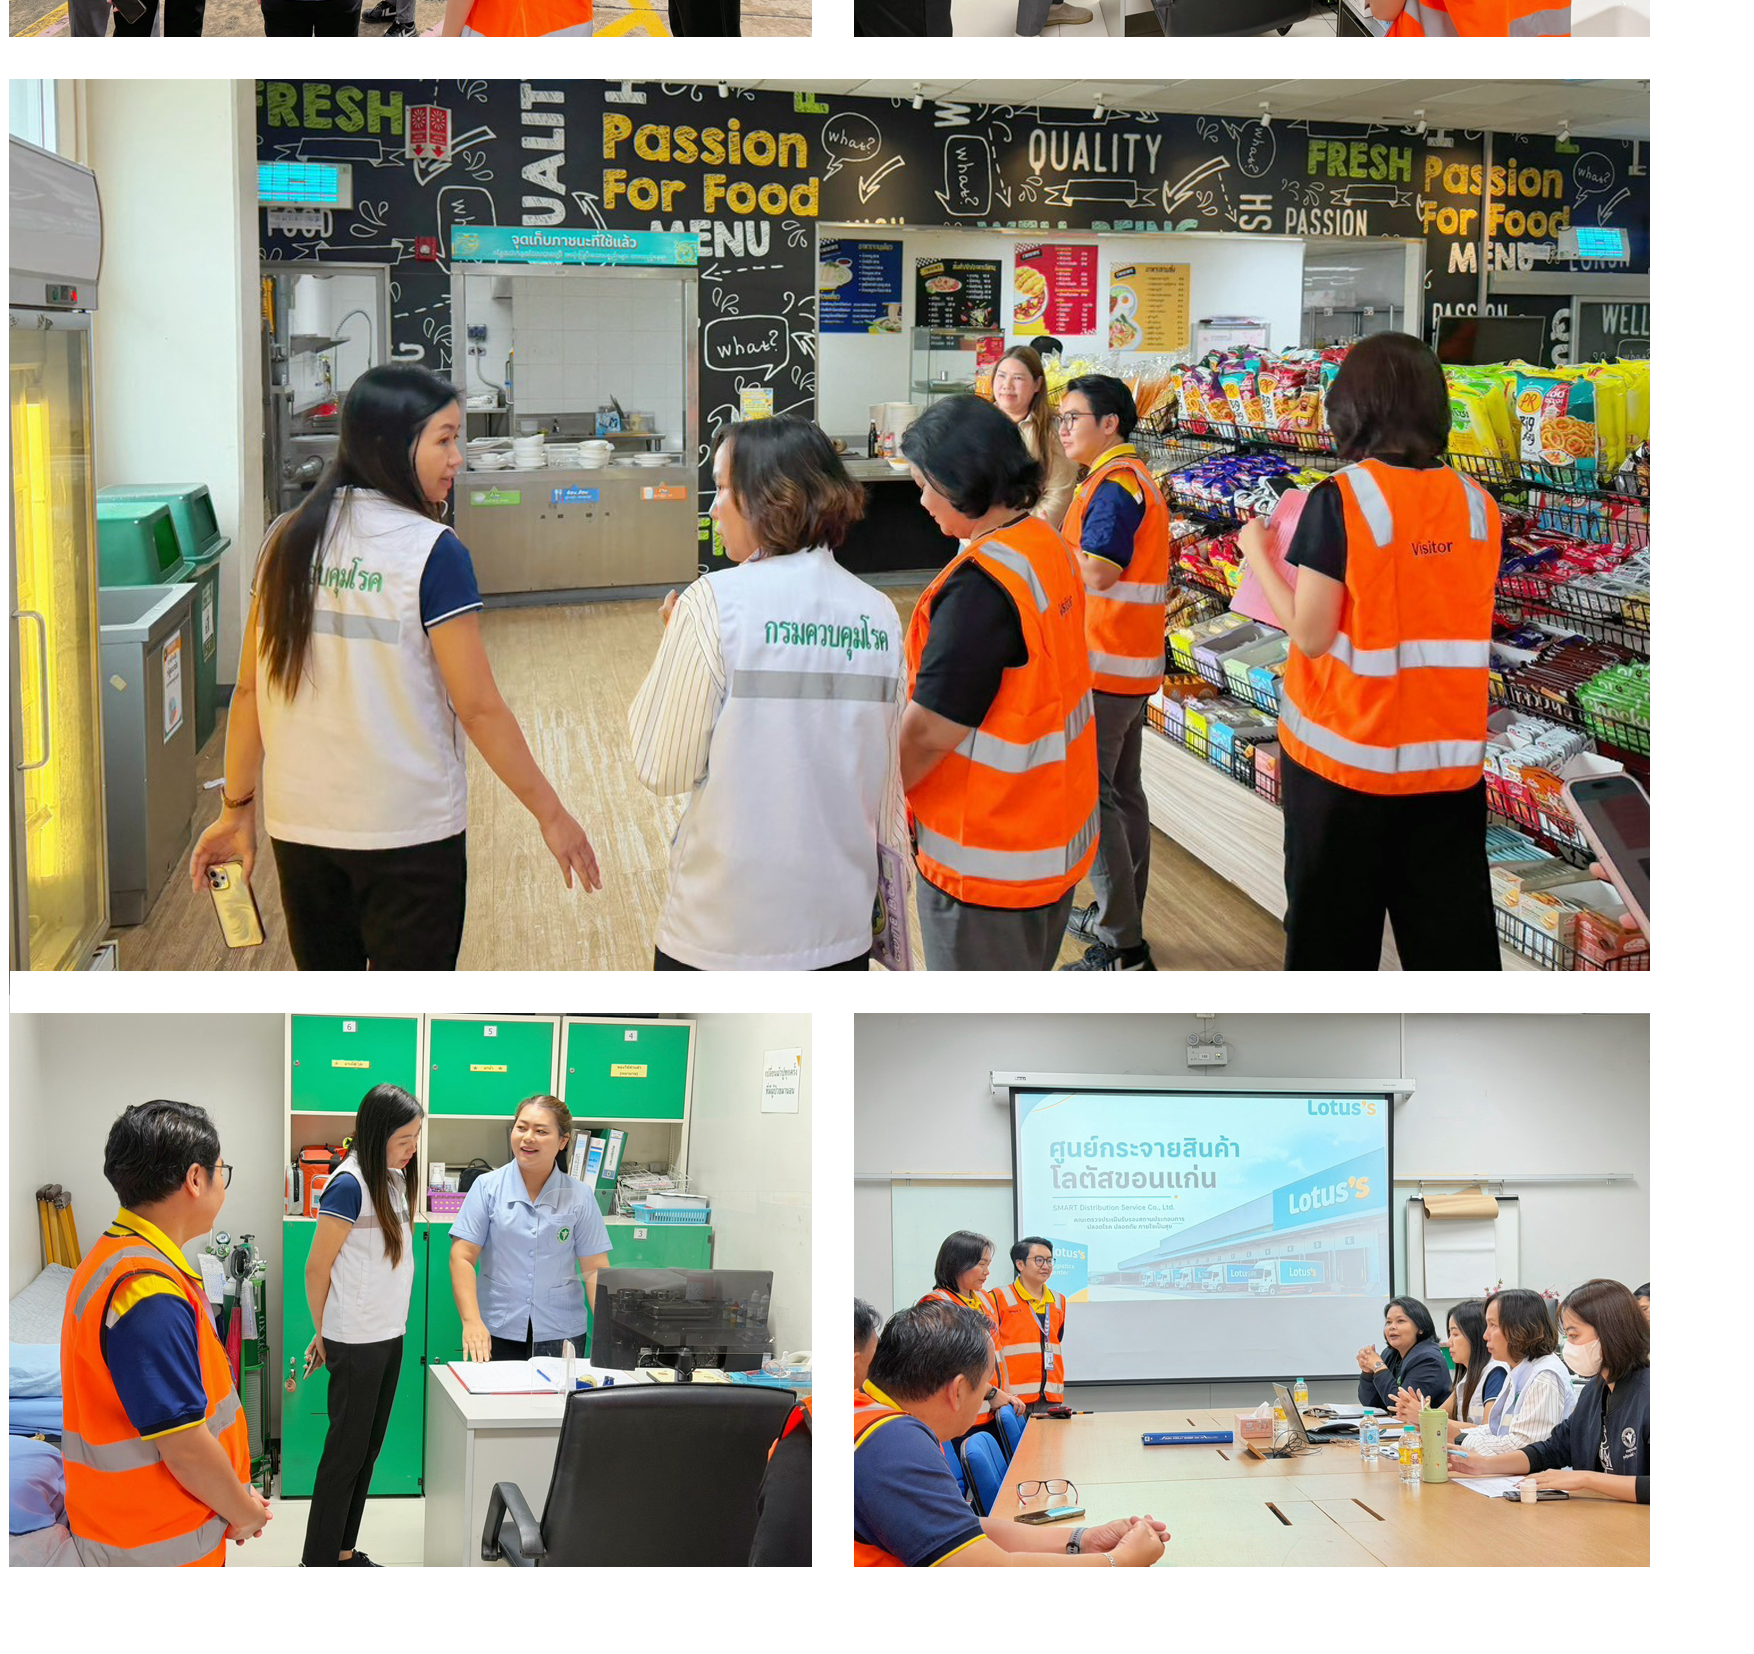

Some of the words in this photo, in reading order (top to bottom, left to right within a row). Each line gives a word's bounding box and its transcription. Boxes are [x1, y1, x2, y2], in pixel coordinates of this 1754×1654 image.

[519, 79, 567, 227] UALIT
[602, 111, 809, 170] Passion
[827, 127, 877, 155] what?
[1027, 128, 1162, 176] QUALITY
[1306, 139, 1413, 183] FRESH
[1424, 154, 1564, 199] Passion
[602, 167, 687, 212] For
[702, 173, 820, 217] Food
[1285, 206, 1368, 236] PASSION
[1423, 199, 1479, 237] For
[510, 229, 639, 251] จุดเก็บภาชนะที่ใช้แล้ว
[649, 219, 771, 258] ENU
[716, 329, 779, 359] what?
[1410, 540, 1454, 556] Visitor
[764, 614, 889, 662] กรมควบคุมโรค
[346, 1022, 353, 1031] 6
[487, 1027, 494, 1036] 5
[628, 1031, 635, 1040] 4
[1306, 1098, 1377, 1117] Lotus's
[1049, 1134, 1241, 1164] ศูนย์กระจายสินค้า
[1050, 1162, 1217, 1190] โลตัสขอนแก่น
[1052, 1204, 1078, 1212] SMART
[1079, 1203, 1120, 1211] Distribution
[1120, 1203, 1146, 1211] Service
[1147, 1203, 1161, 1212] Co.,
[1162, 1203, 1176, 1211] Ltd.
[1288, 1175, 1371, 1215] Lotus's
[637, 1230, 643, 1239] 3
[1288, 1266, 1317, 1278] Lotus's
